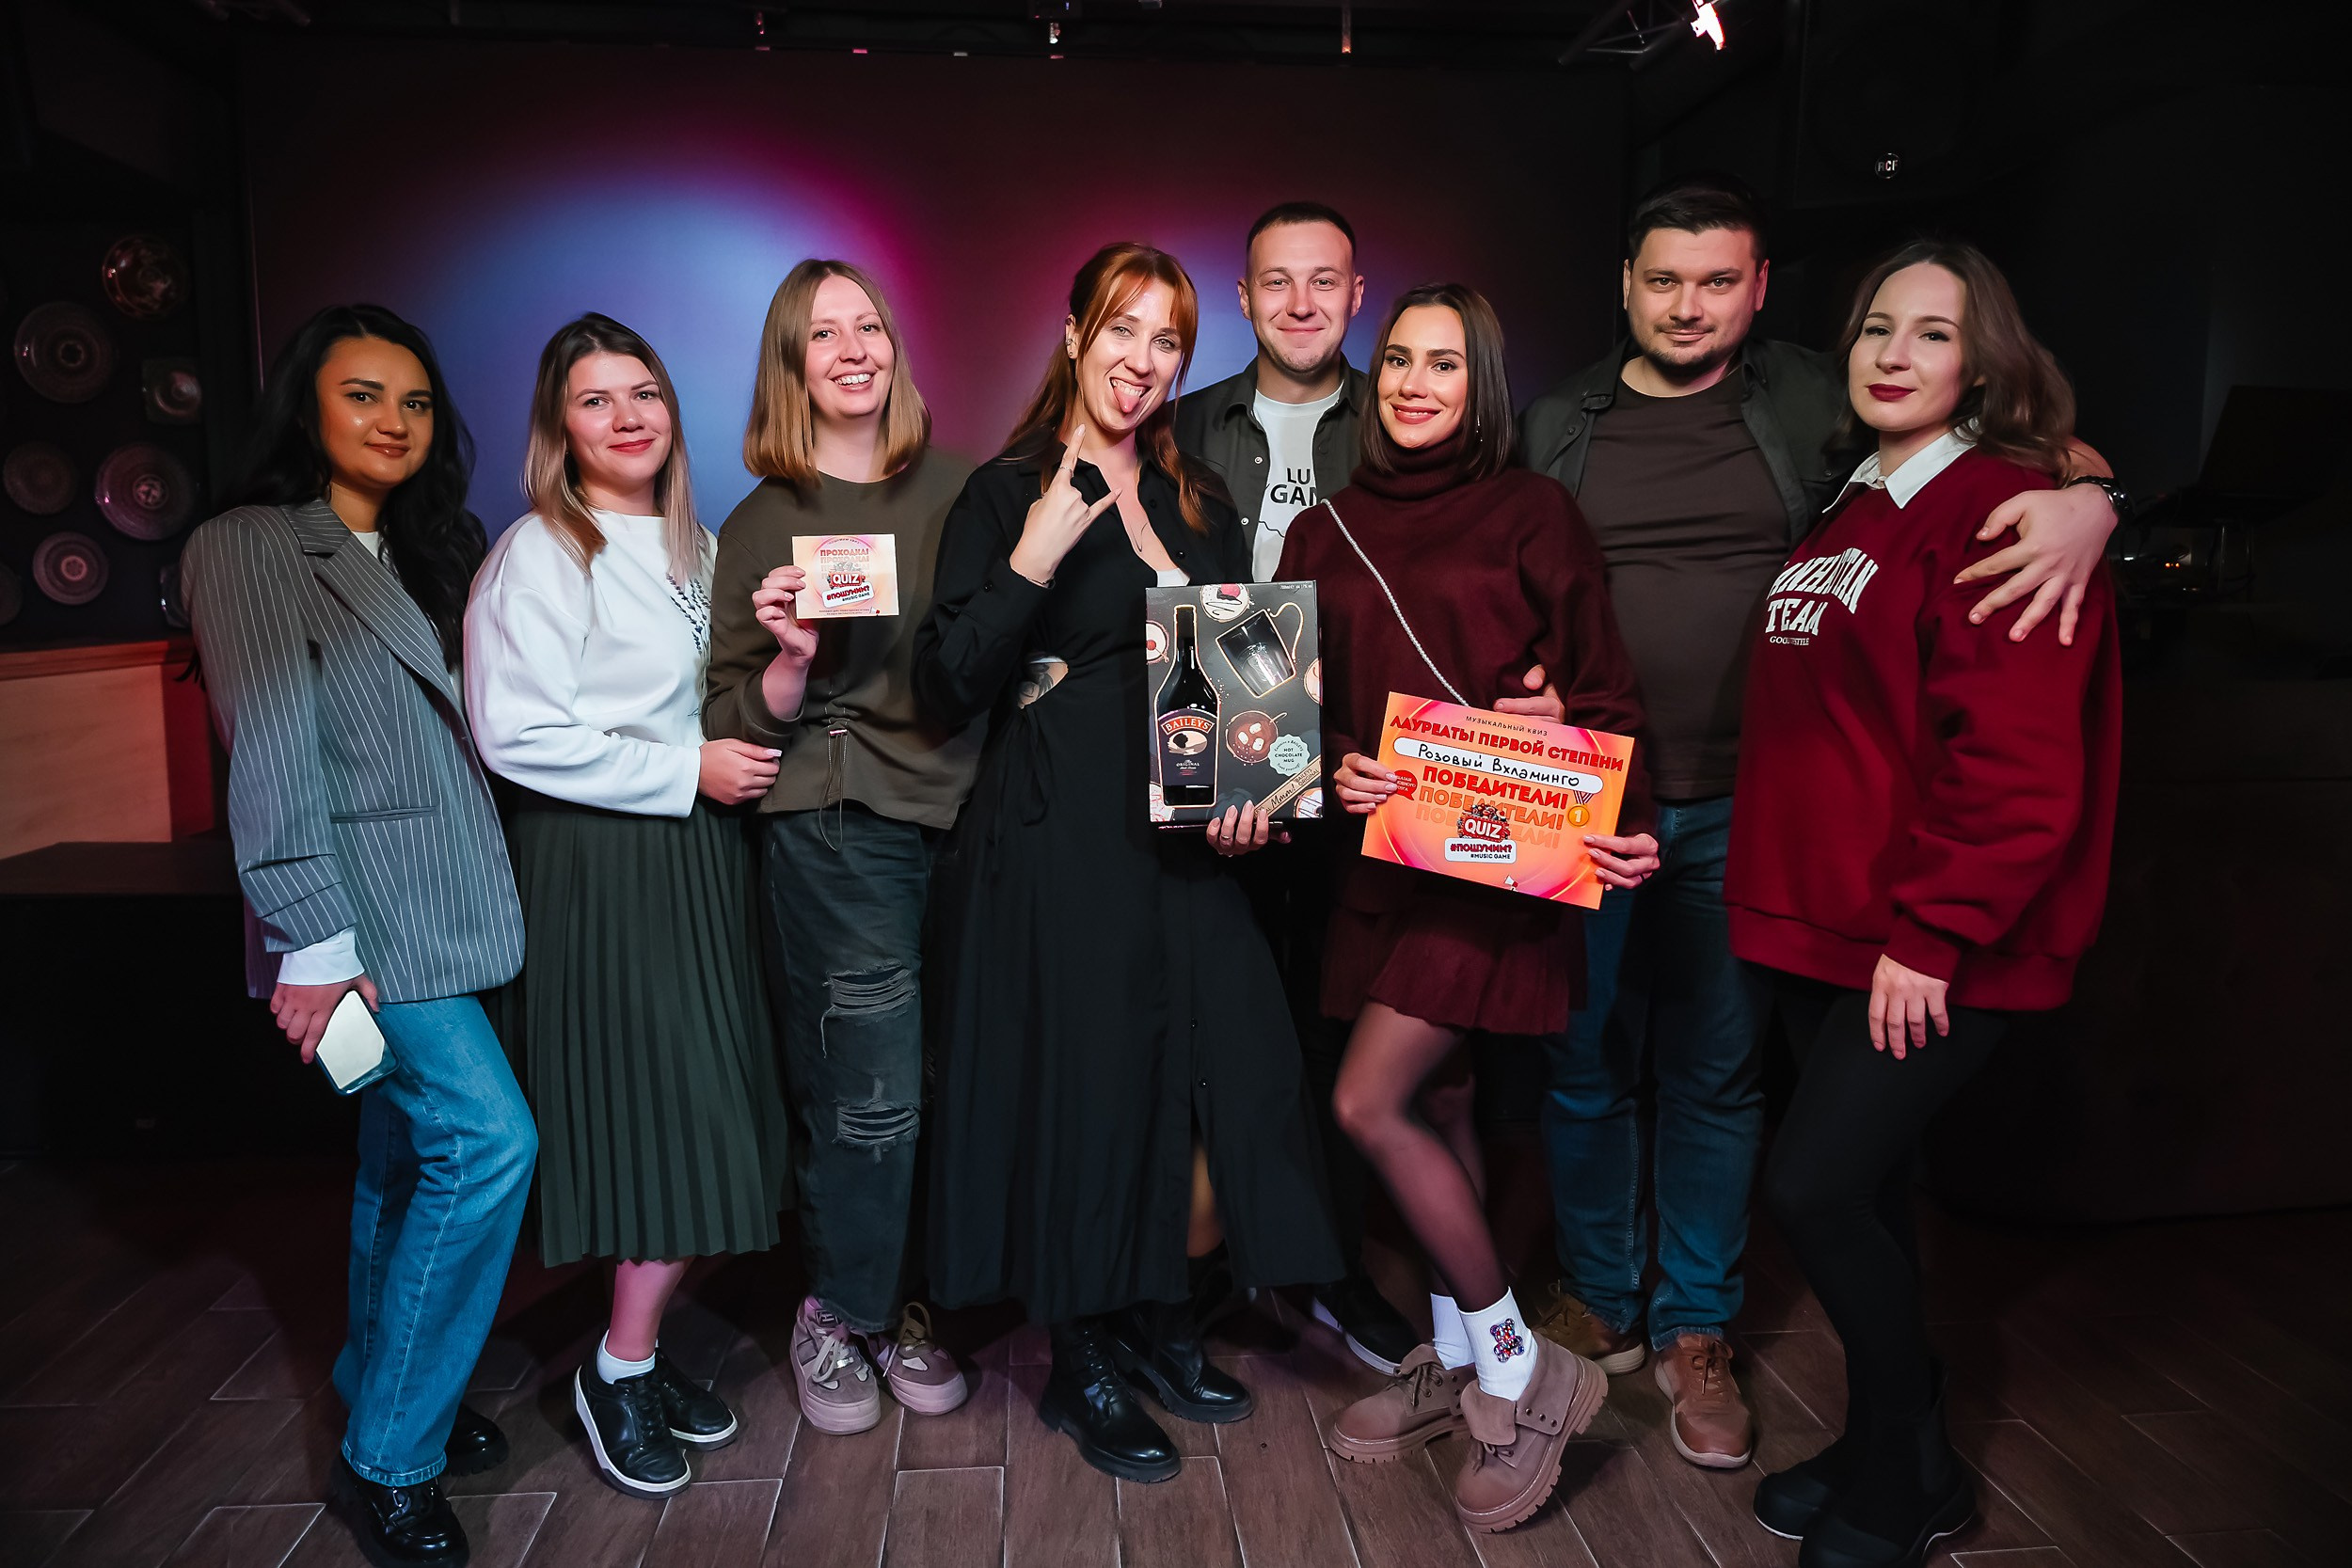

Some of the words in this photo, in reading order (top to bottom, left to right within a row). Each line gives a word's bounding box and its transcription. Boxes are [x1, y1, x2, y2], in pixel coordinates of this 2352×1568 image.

[1878, 160, 1898, 171] RCF
[1287, 467, 1311, 484] LU
[833, 574, 860, 584] QUIZ
[1765, 598, 1828, 636] TEAM
[1166, 719, 1210, 731] BAILEYS
[1466, 716, 1524, 732] МУЗЫКАЛЬНЫЙ
[1527, 728, 1548, 736] КВИЗ
[1391, 715, 1475, 742] ЛАУРЕАТЫ
[1478, 732, 1545, 756] ПЕРВОЙ
[1548, 746, 1624, 771] СТЕПЕНИ
[1418, 743, 1483, 768] Розовый
[1493, 758, 1580, 786] Вхламинго
[1422, 766, 1568, 809] ПОБЕДИТЕЛИ!
[1574, 809, 1583, 823] 1
[1464, 818, 1502, 839] QUIZ
